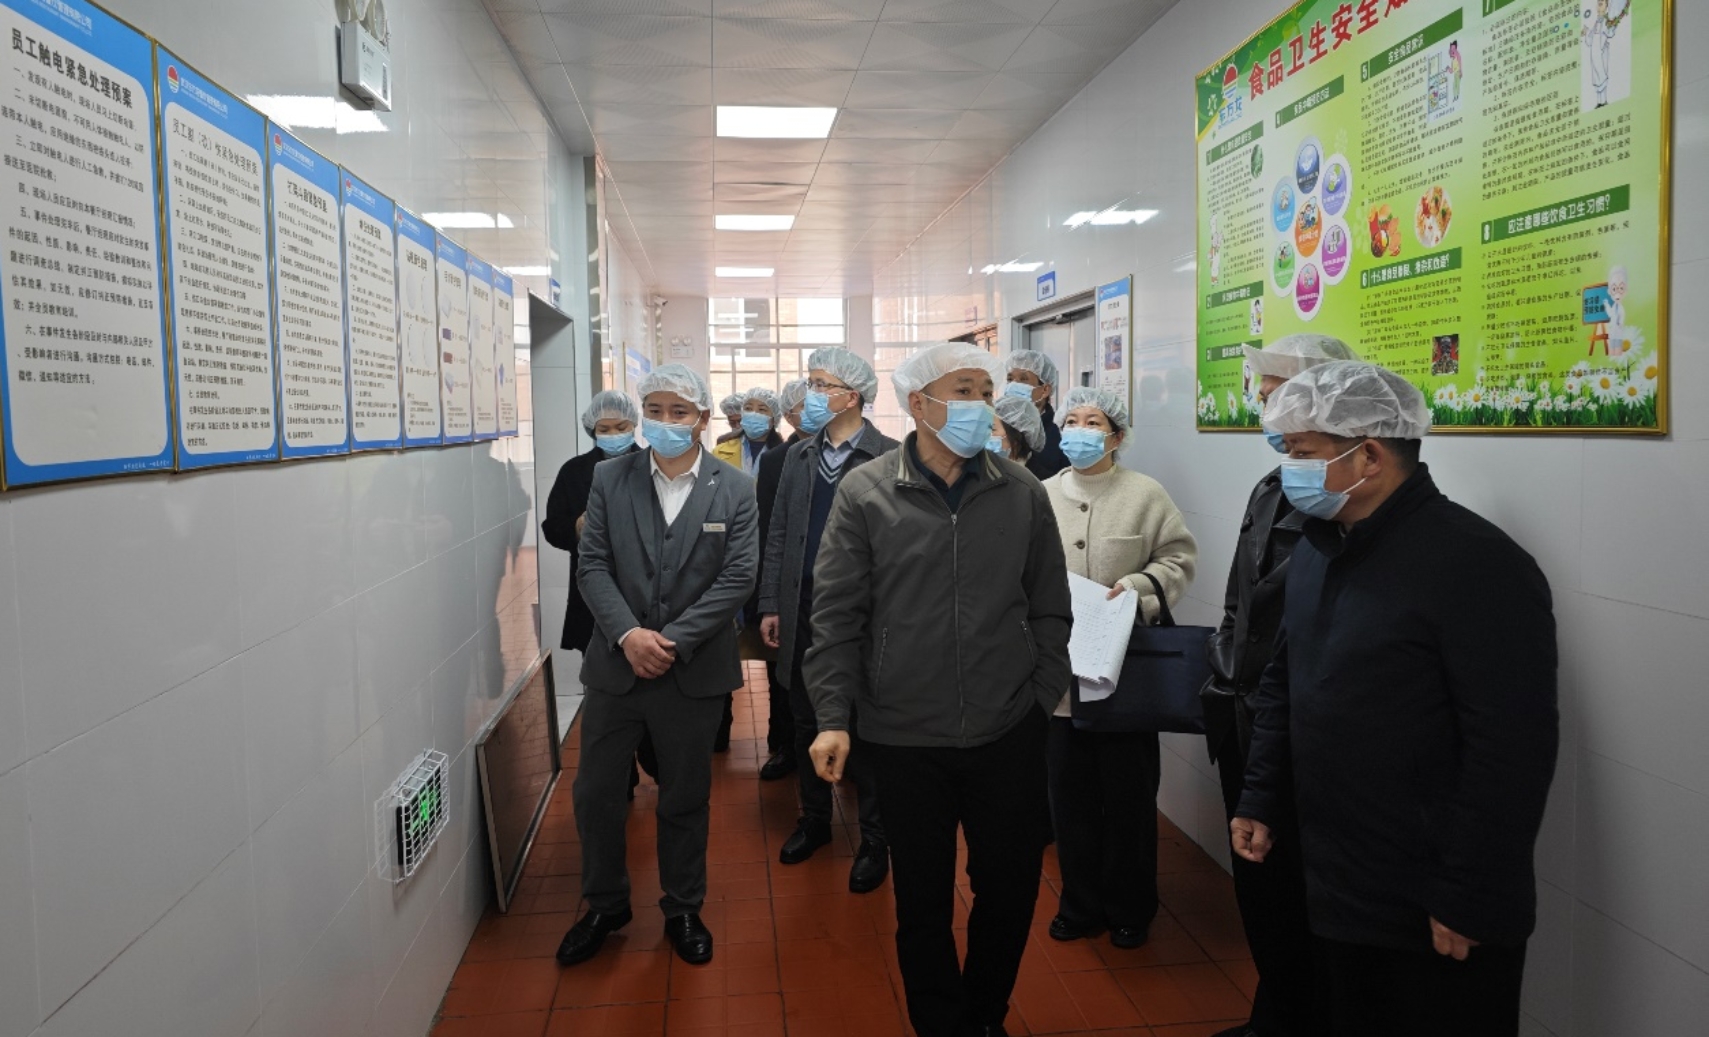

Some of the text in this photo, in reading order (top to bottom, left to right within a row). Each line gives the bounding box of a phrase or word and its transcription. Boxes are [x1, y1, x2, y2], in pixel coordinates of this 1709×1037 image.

[11, 27, 133, 110] 员工触电紧急处理预案
[1361, 63, 1369, 81] 5
[1483, 224, 1490, 241] 8
[1362, 273, 1368, 289] 6
